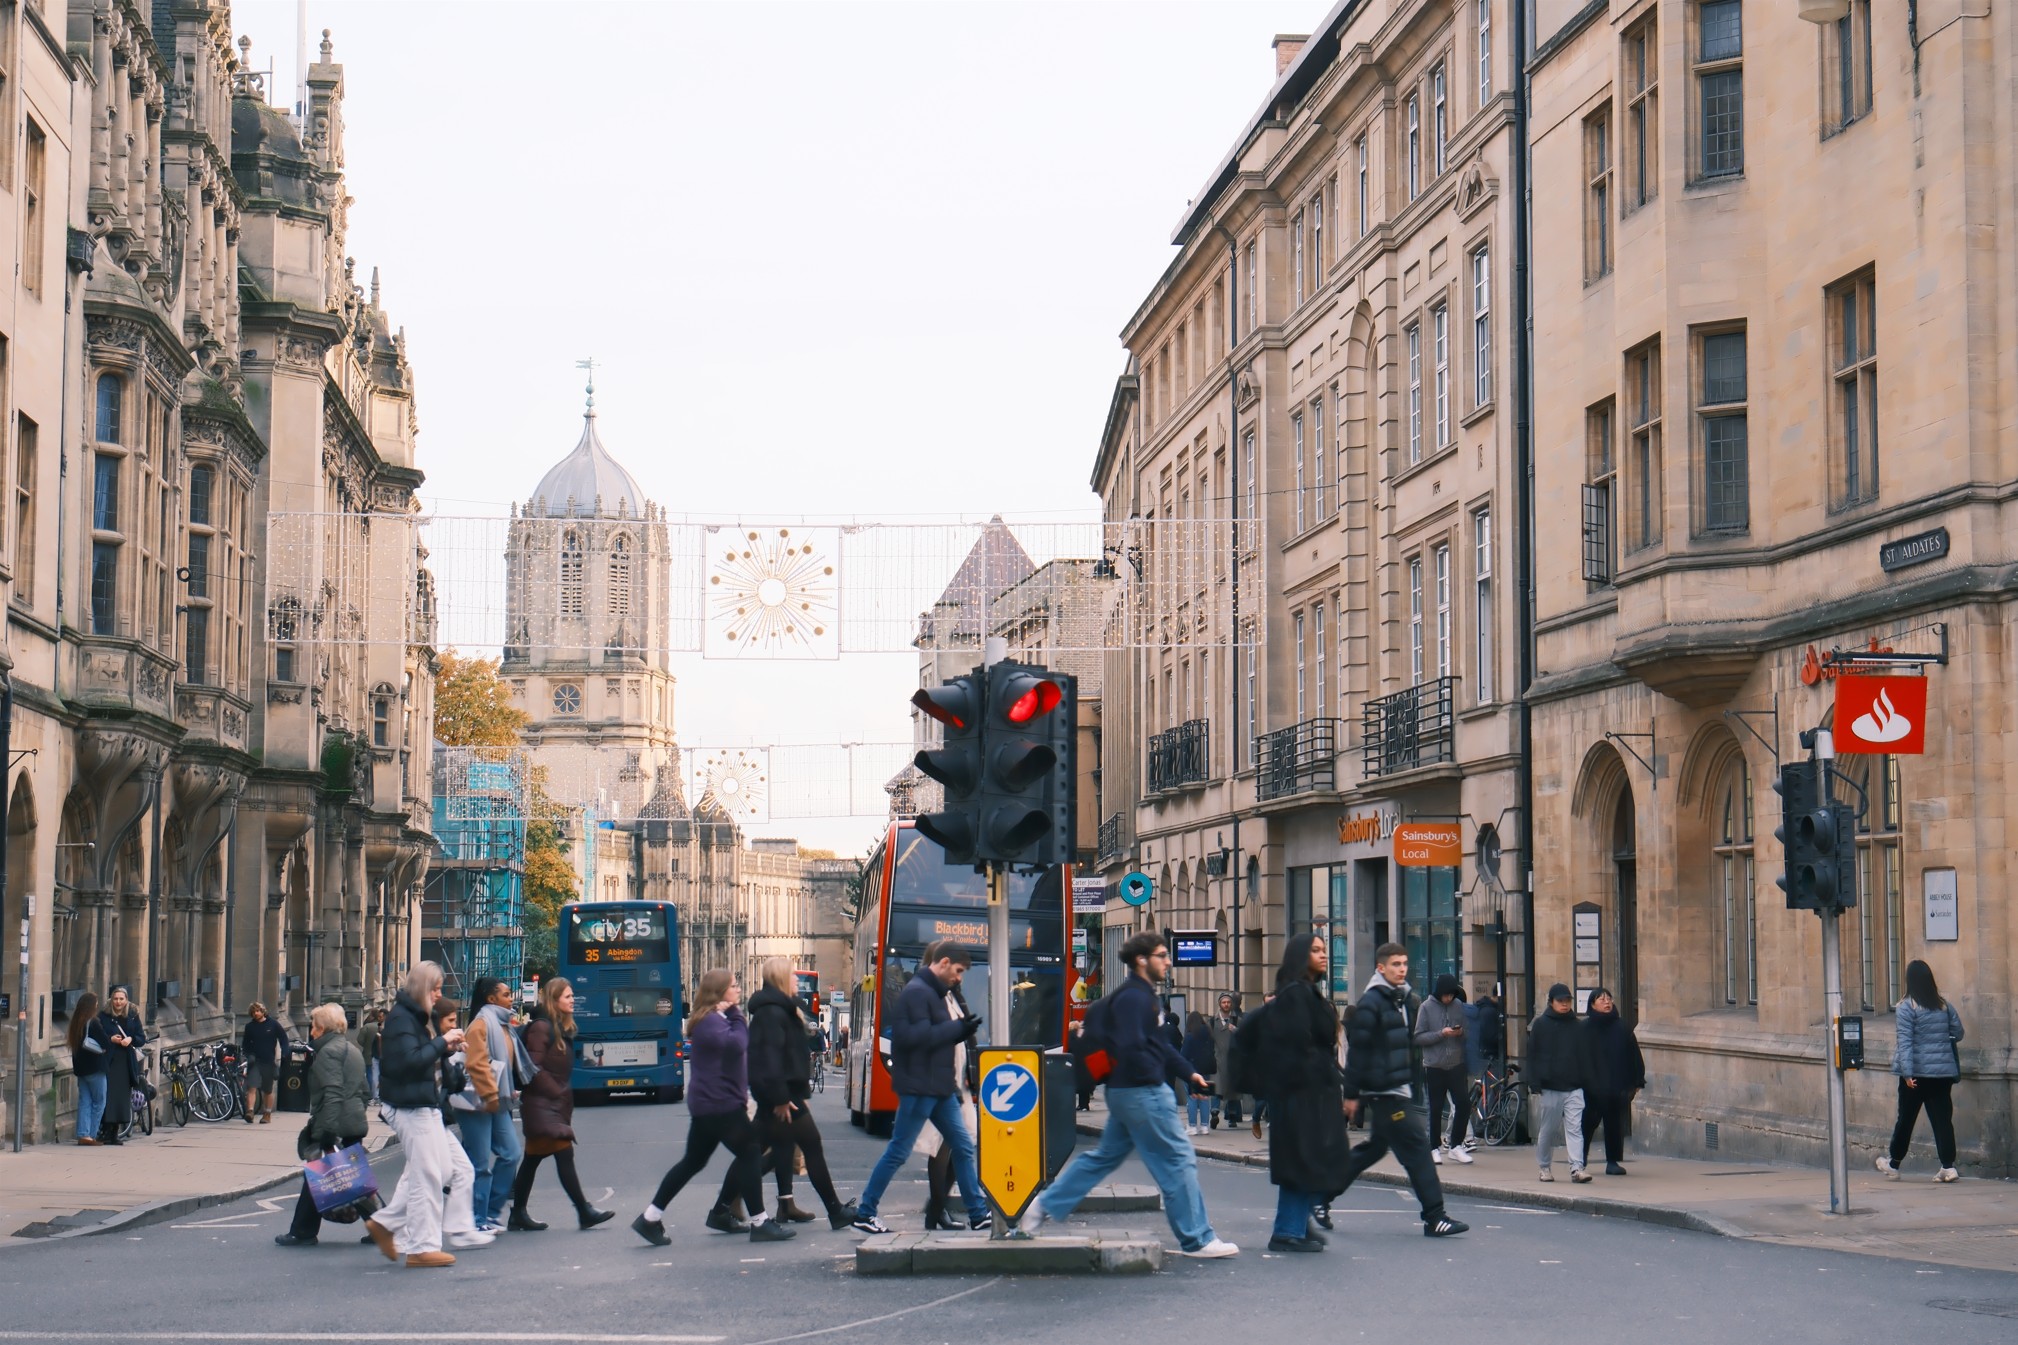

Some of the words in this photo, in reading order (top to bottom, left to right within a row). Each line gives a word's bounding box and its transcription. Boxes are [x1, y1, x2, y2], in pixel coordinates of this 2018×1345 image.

[1886, 548, 1896, 563] ST
[1902, 535, 1941, 560] ALDATES
[1338, 810, 1380, 848] Sainsbury's
[1402, 830, 1457, 843] Sainsbury's
[1402, 849, 1429, 859] Local
[590, 919, 622, 940] city
[624, 918, 652, 937] 35
[936, 920, 984, 936] Blackbird
[585, 949, 600, 962] 35
[607, 948, 643, 958] Abingdon
